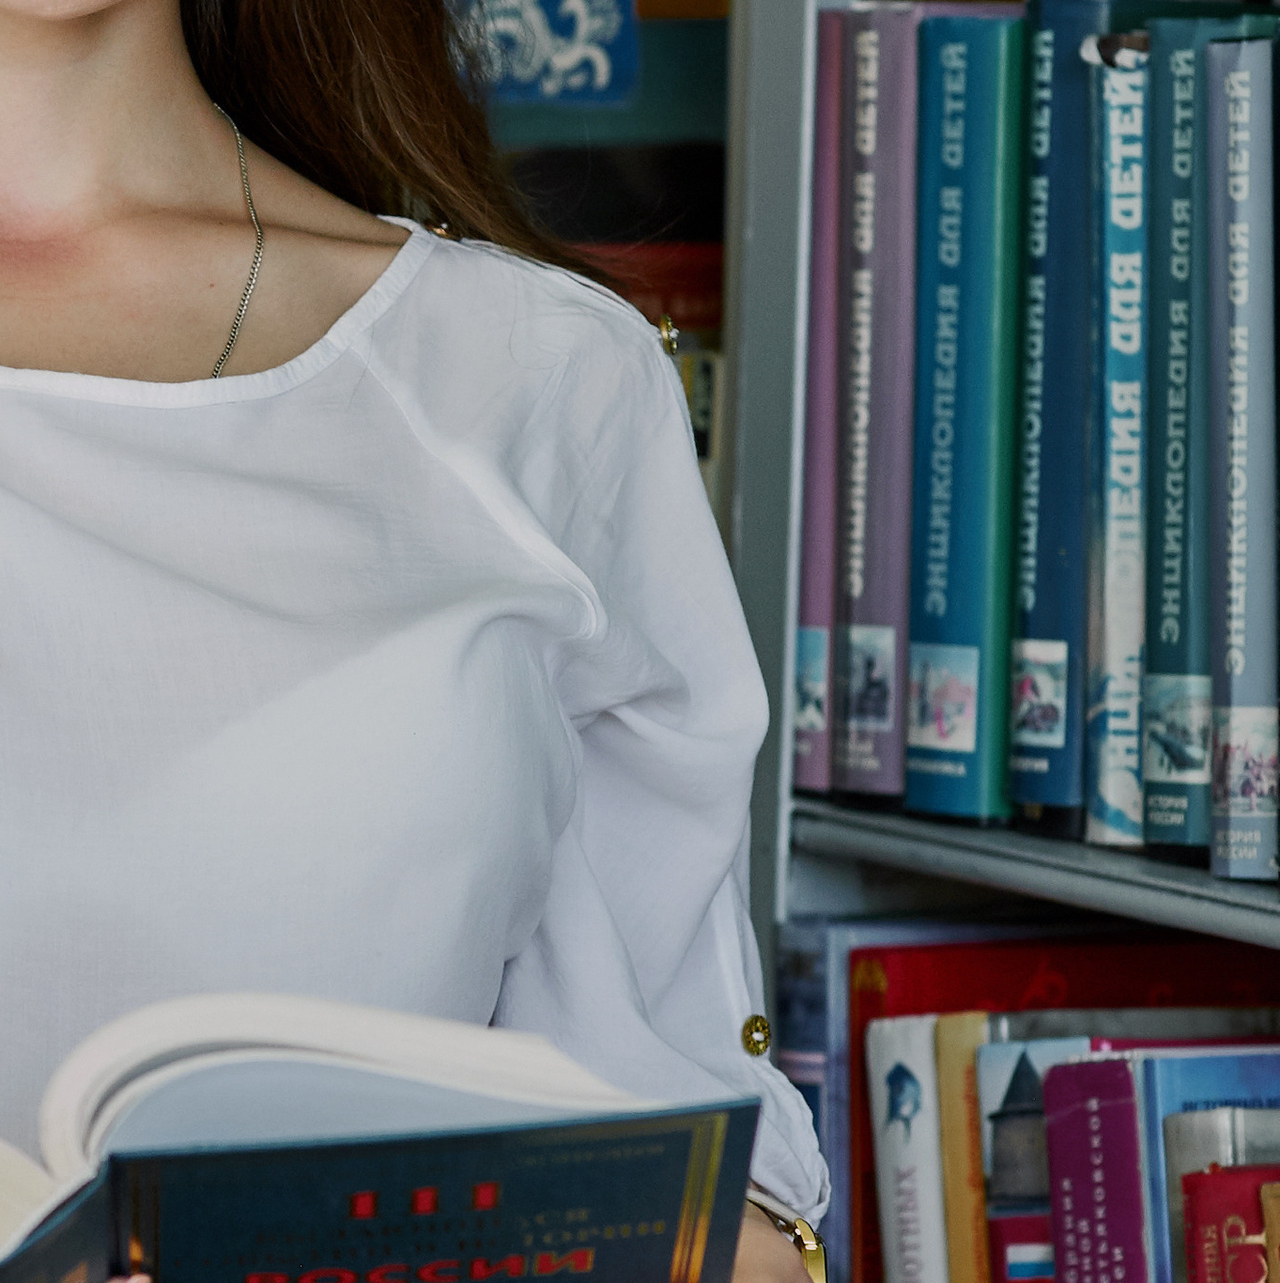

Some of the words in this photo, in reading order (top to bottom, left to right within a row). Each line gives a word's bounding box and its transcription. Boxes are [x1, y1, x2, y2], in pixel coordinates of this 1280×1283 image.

[853, 29, 880, 156] ДЕТЕЙ
[941, 42, 969, 169] ДЕТЕЙ
[1104, 67, 1147, 230] ДЕТЕЙ
[1169, 48, 1196, 179] ДЕТЕЙ
[1226, 70, 1253, 202] ДЕТЕЙ
[852, 171, 876, 253] ДЛЯ
[938, 187, 963, 268] ДЛЯ
[1169, 198, 1192, 282] ДЛЯ
[1226, 221, 1251, 305] ДЛЯ
[1110, 250, 1143, 355] ДЛЯ
[924, 284, 960, 617] ЭНЦИКЛОПЕДИЯ
[1160, 299, 1190, 644] ЭНЦИКЛОПЕДИЯ
[1223, 325, 1250, 676] ЭНЦИКЛОПЕДИЯ
[1104, 378, 1145, 820] НЦИОПЕДИЯ
